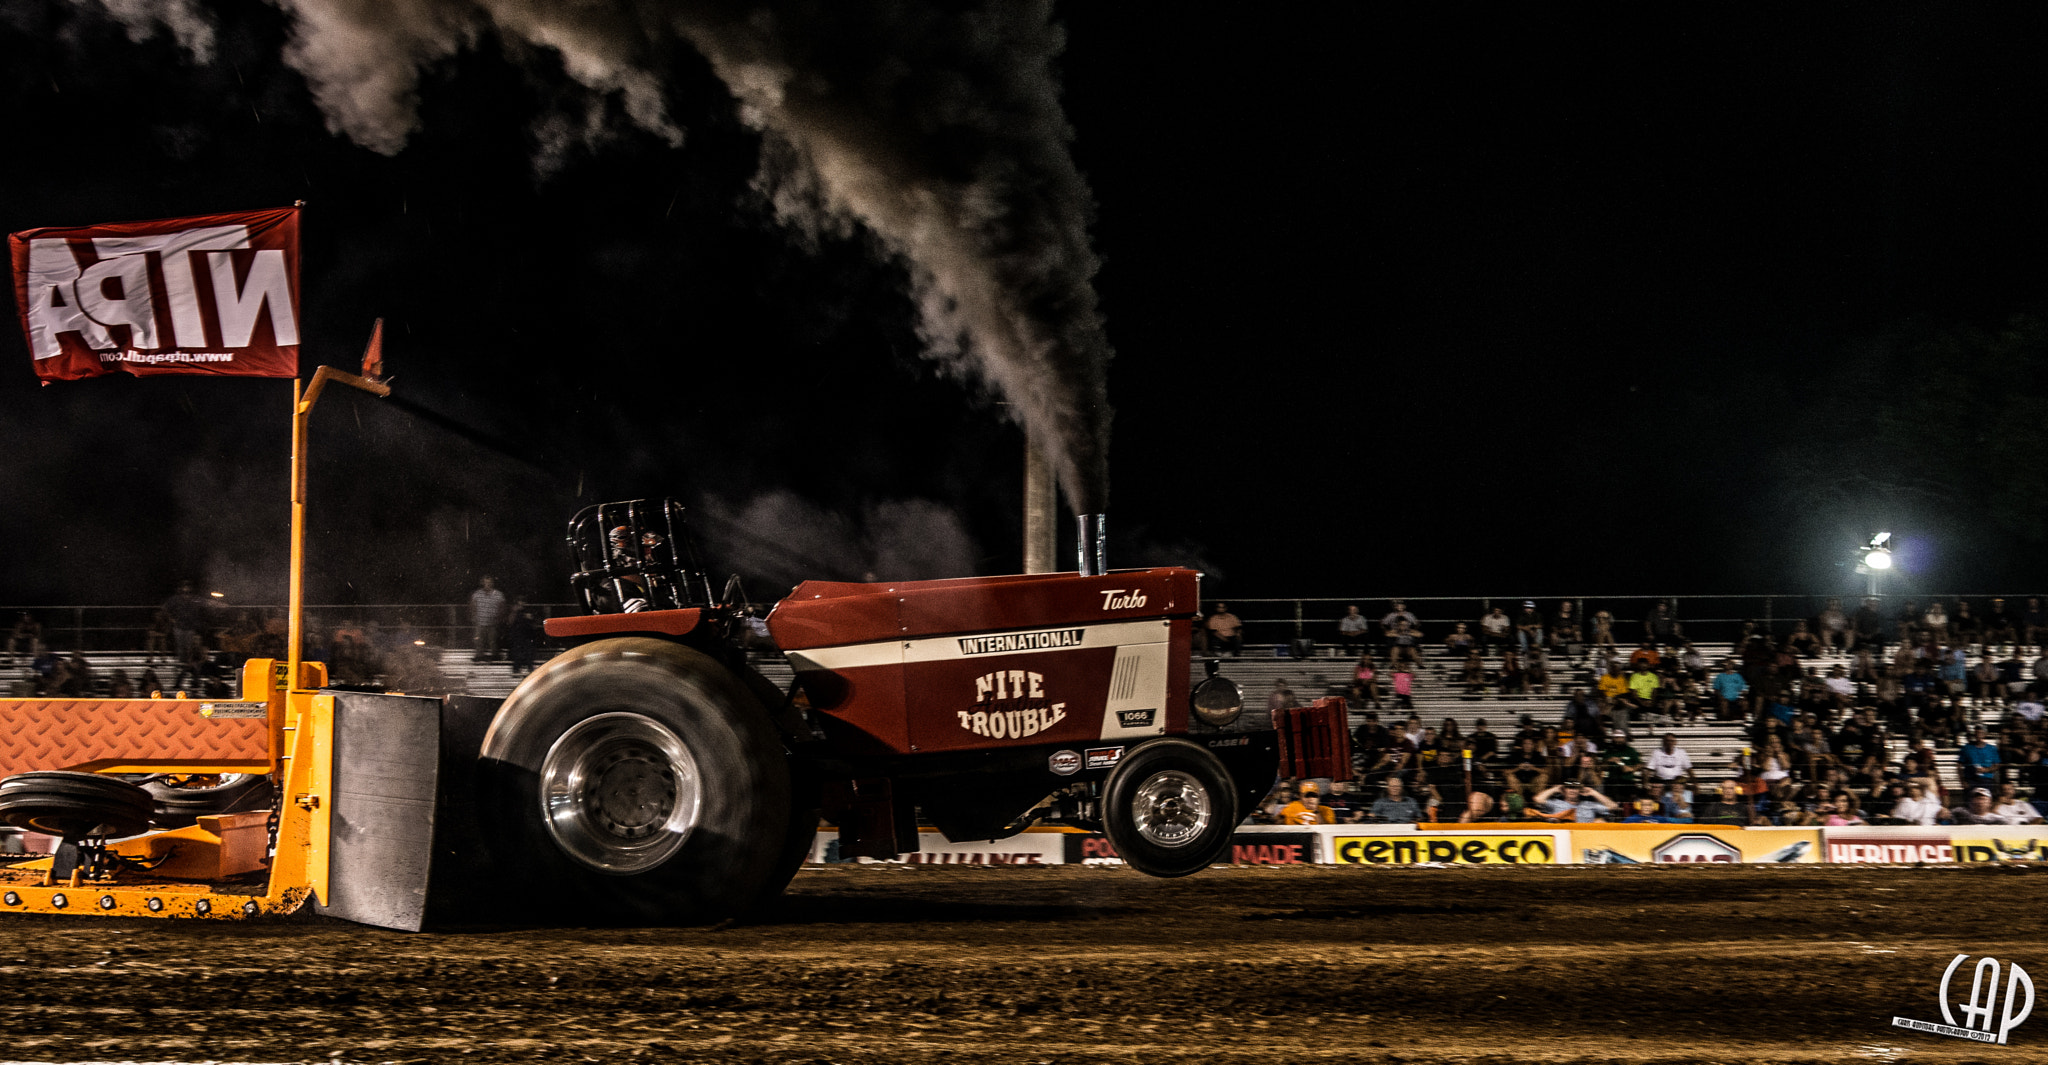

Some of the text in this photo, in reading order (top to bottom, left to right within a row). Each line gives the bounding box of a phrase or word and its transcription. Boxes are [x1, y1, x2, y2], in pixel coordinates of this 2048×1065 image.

[1100, 588, 1148, 611] Turbo
[962, 630, 1081, 654] INTERNATIONAL
[975, 670, 1044, 702] NITE
[957, 702, 1067, 739] TROUBLE
[1124, 711, 1148, 721] 1066
[1233, 845, 1304, 864] MADE
